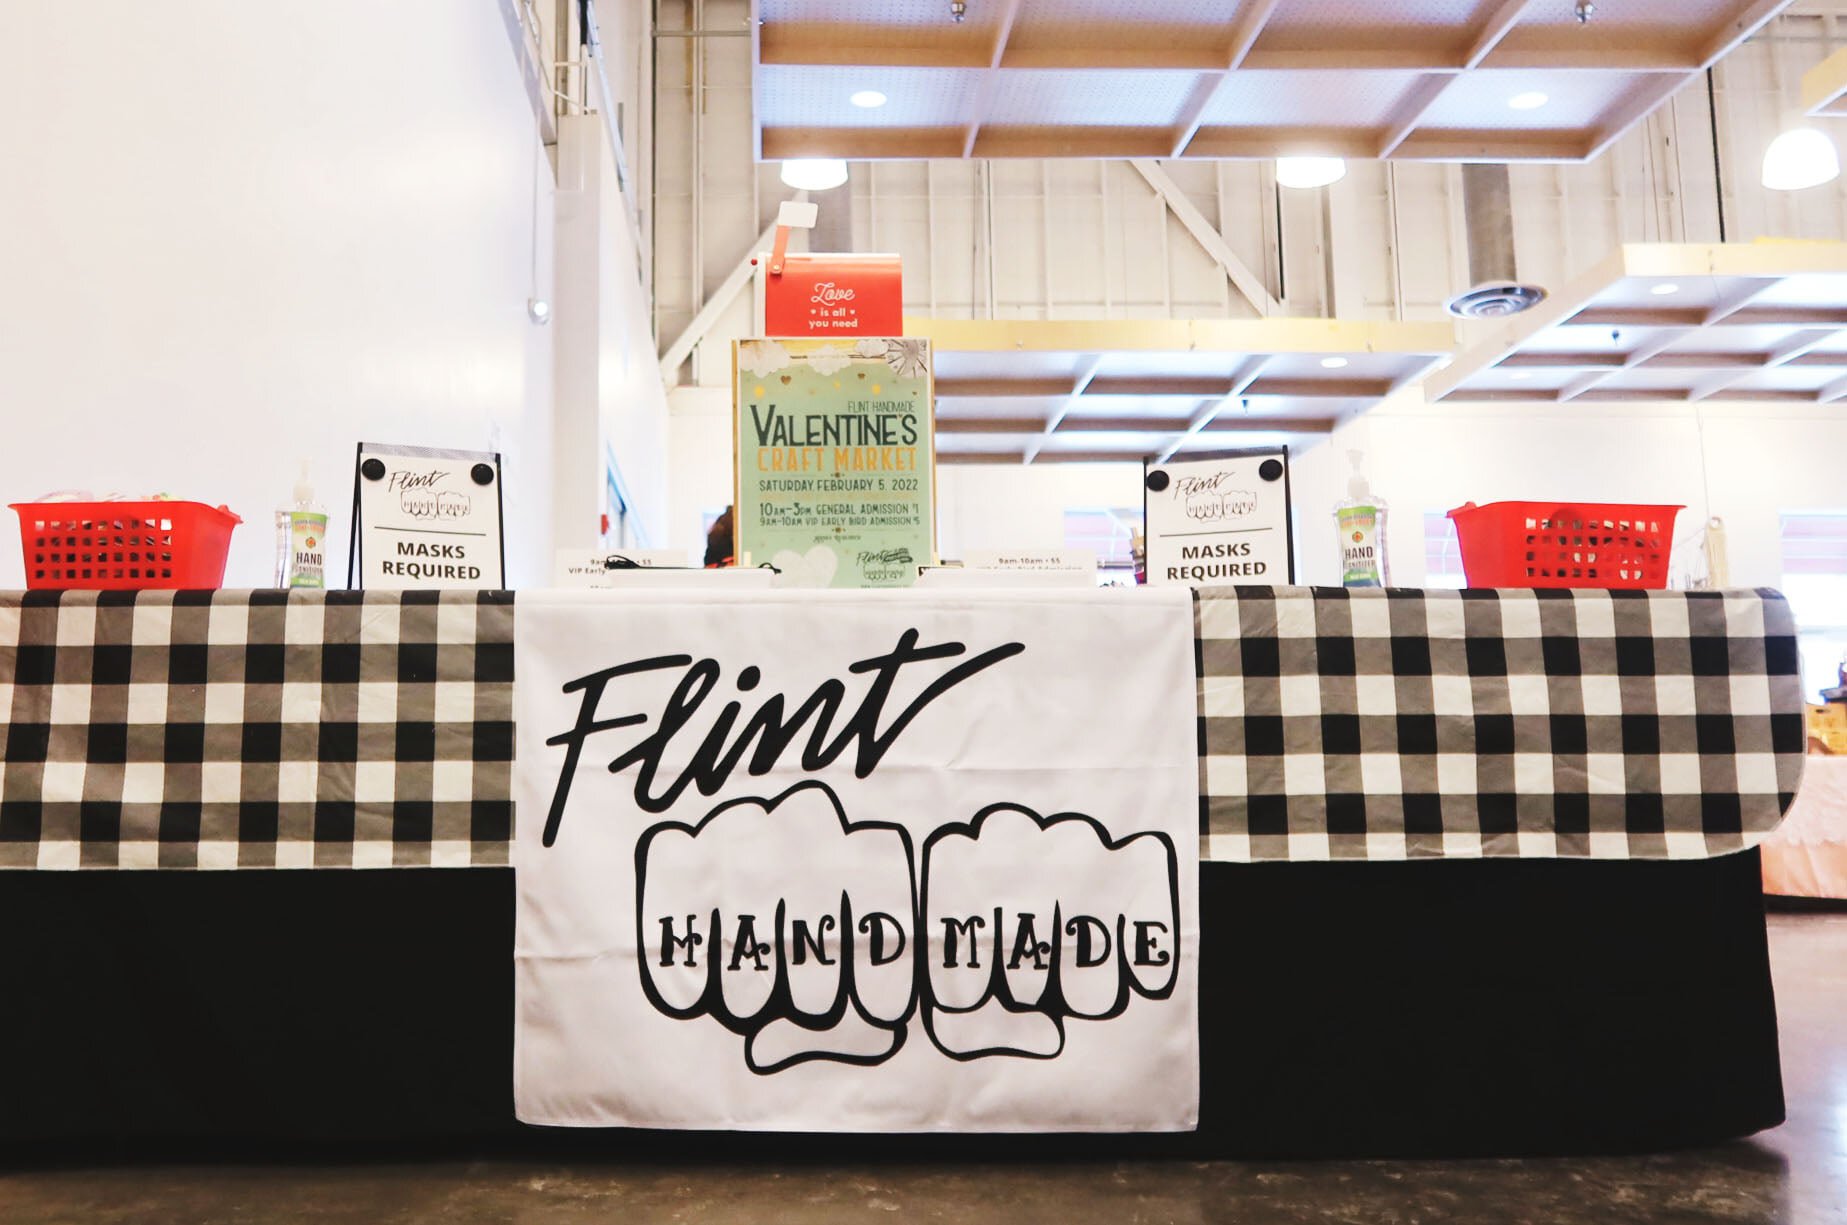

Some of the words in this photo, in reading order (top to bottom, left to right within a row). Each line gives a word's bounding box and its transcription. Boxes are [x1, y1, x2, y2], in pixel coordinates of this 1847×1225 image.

[810, 282, 855, 306] Love
[820, 307, 829, 317] is
[832, 307, 846, 317] all
[809, 320, 829, 330] you
[832, 319, 858, 328] need
[847, 401, 869, 412] FLINT
[872, 400, 915, 412] HANDMADE
[757, 447, 825, 472] CRAFT
[834, 447, 917, 472] MARKET
[388, 470, 451, 492] Flint
[817, 479, 874, 491] FEBRUARY
[892, 478, 919, 491] 2022
[1174, 471, 1236, 500] Flint
[816, 503, 856, 515] GENERAL
[860, 503, 909, 515] ADMISSION
[806, 517, 819, 526] VIP
[821, 517, 847, 526] EARLY
[849, 517, 867, 526] BIRD
[870, 516, 912, 526] ADMISSION
[397, 541, 465, 559] MASKS
[1182, 542, 1251, 560] MASKS
[1345, 546, 1373, 560] HAND
[296, 551, 322, 566] HAND
[382, 560, 481, 580] REQUIRED
[585, 567, 606, 576] Early
[1167, 561, 1267, 582] REQUIRED
[541, 627, 1025, 848] Flint
